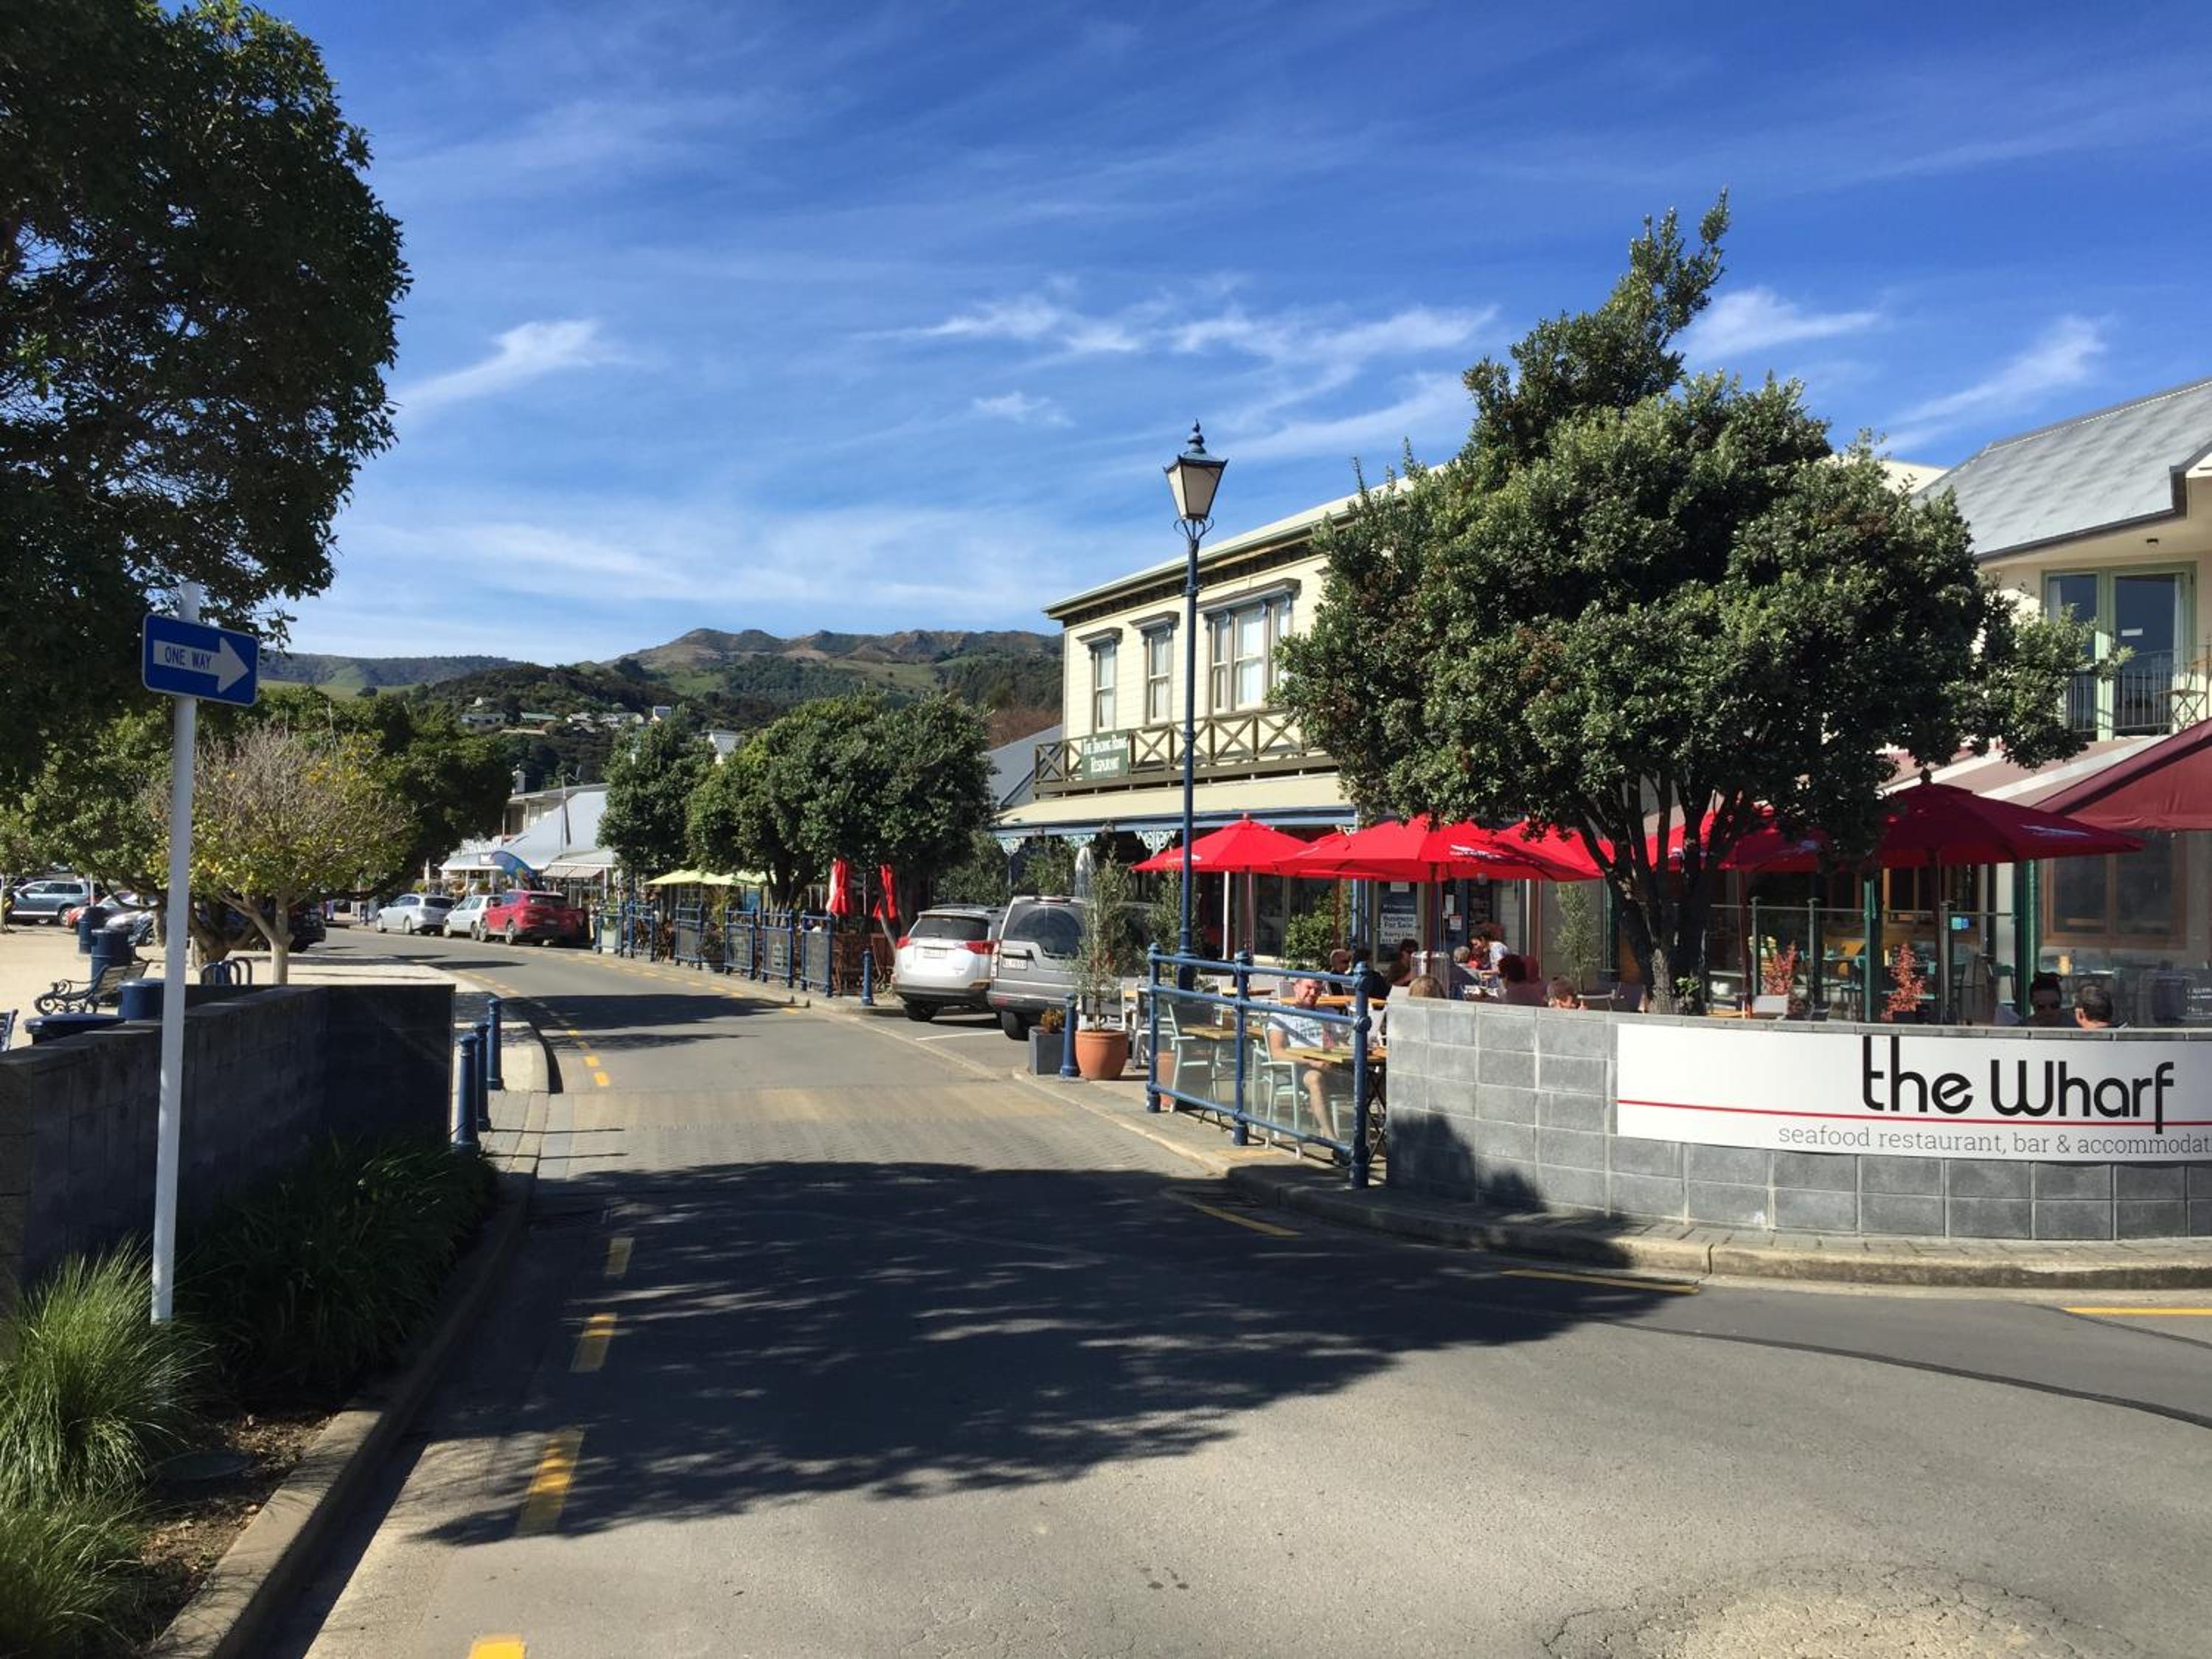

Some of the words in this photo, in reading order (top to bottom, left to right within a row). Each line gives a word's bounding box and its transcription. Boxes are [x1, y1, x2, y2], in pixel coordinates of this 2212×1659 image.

[164, 646, 185, 665] ONE
[191, 654, 212, 670] WAY
[1863, 1035, 1974, 1115] the
[1990, 1060, 2174, 1135] Wharf
[1778, 1124, 1871, 1147] seafood
[1879, 1131, 2007, 1155] restaurant,
[2013, 1133, 2051, 1153] bar
[2056, 1133, 2071, 1154] &
